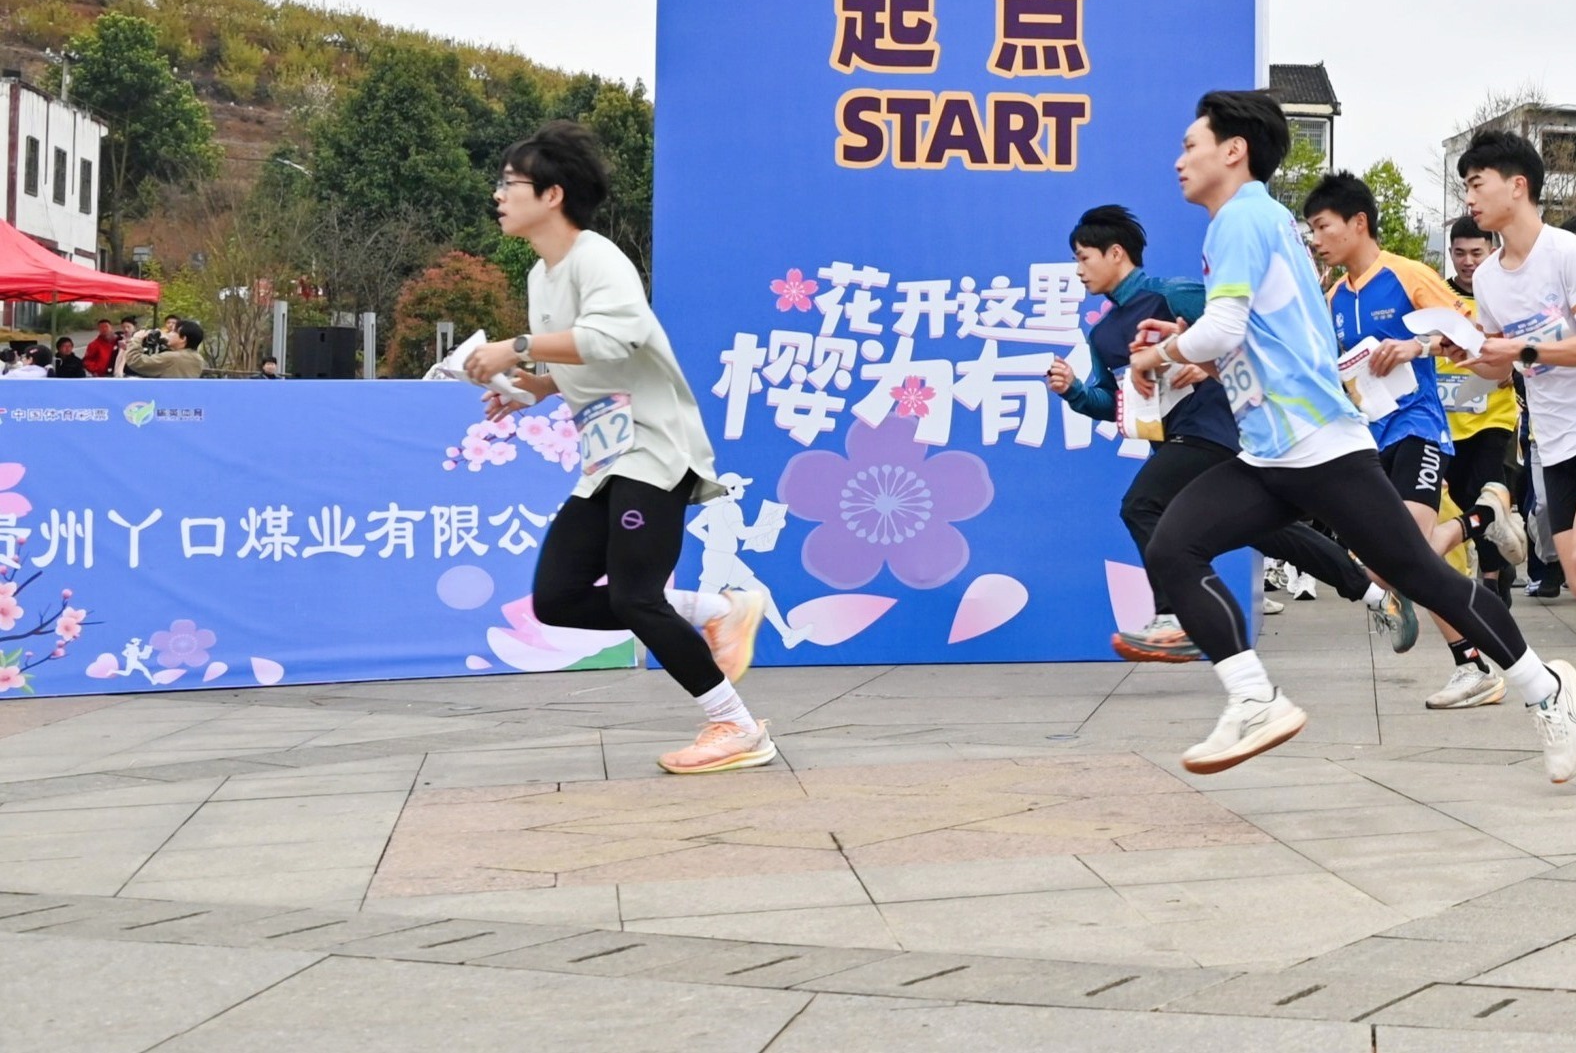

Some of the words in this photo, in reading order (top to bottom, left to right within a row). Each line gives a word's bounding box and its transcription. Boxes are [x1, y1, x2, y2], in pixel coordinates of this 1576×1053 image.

[838, 91, 1088, 170] START
[815, 260, 1087, 345] 花开这里
[582, 413, 631, 460] 012
[0, 502, 565, 569] 贵州丫口煤业有限公
